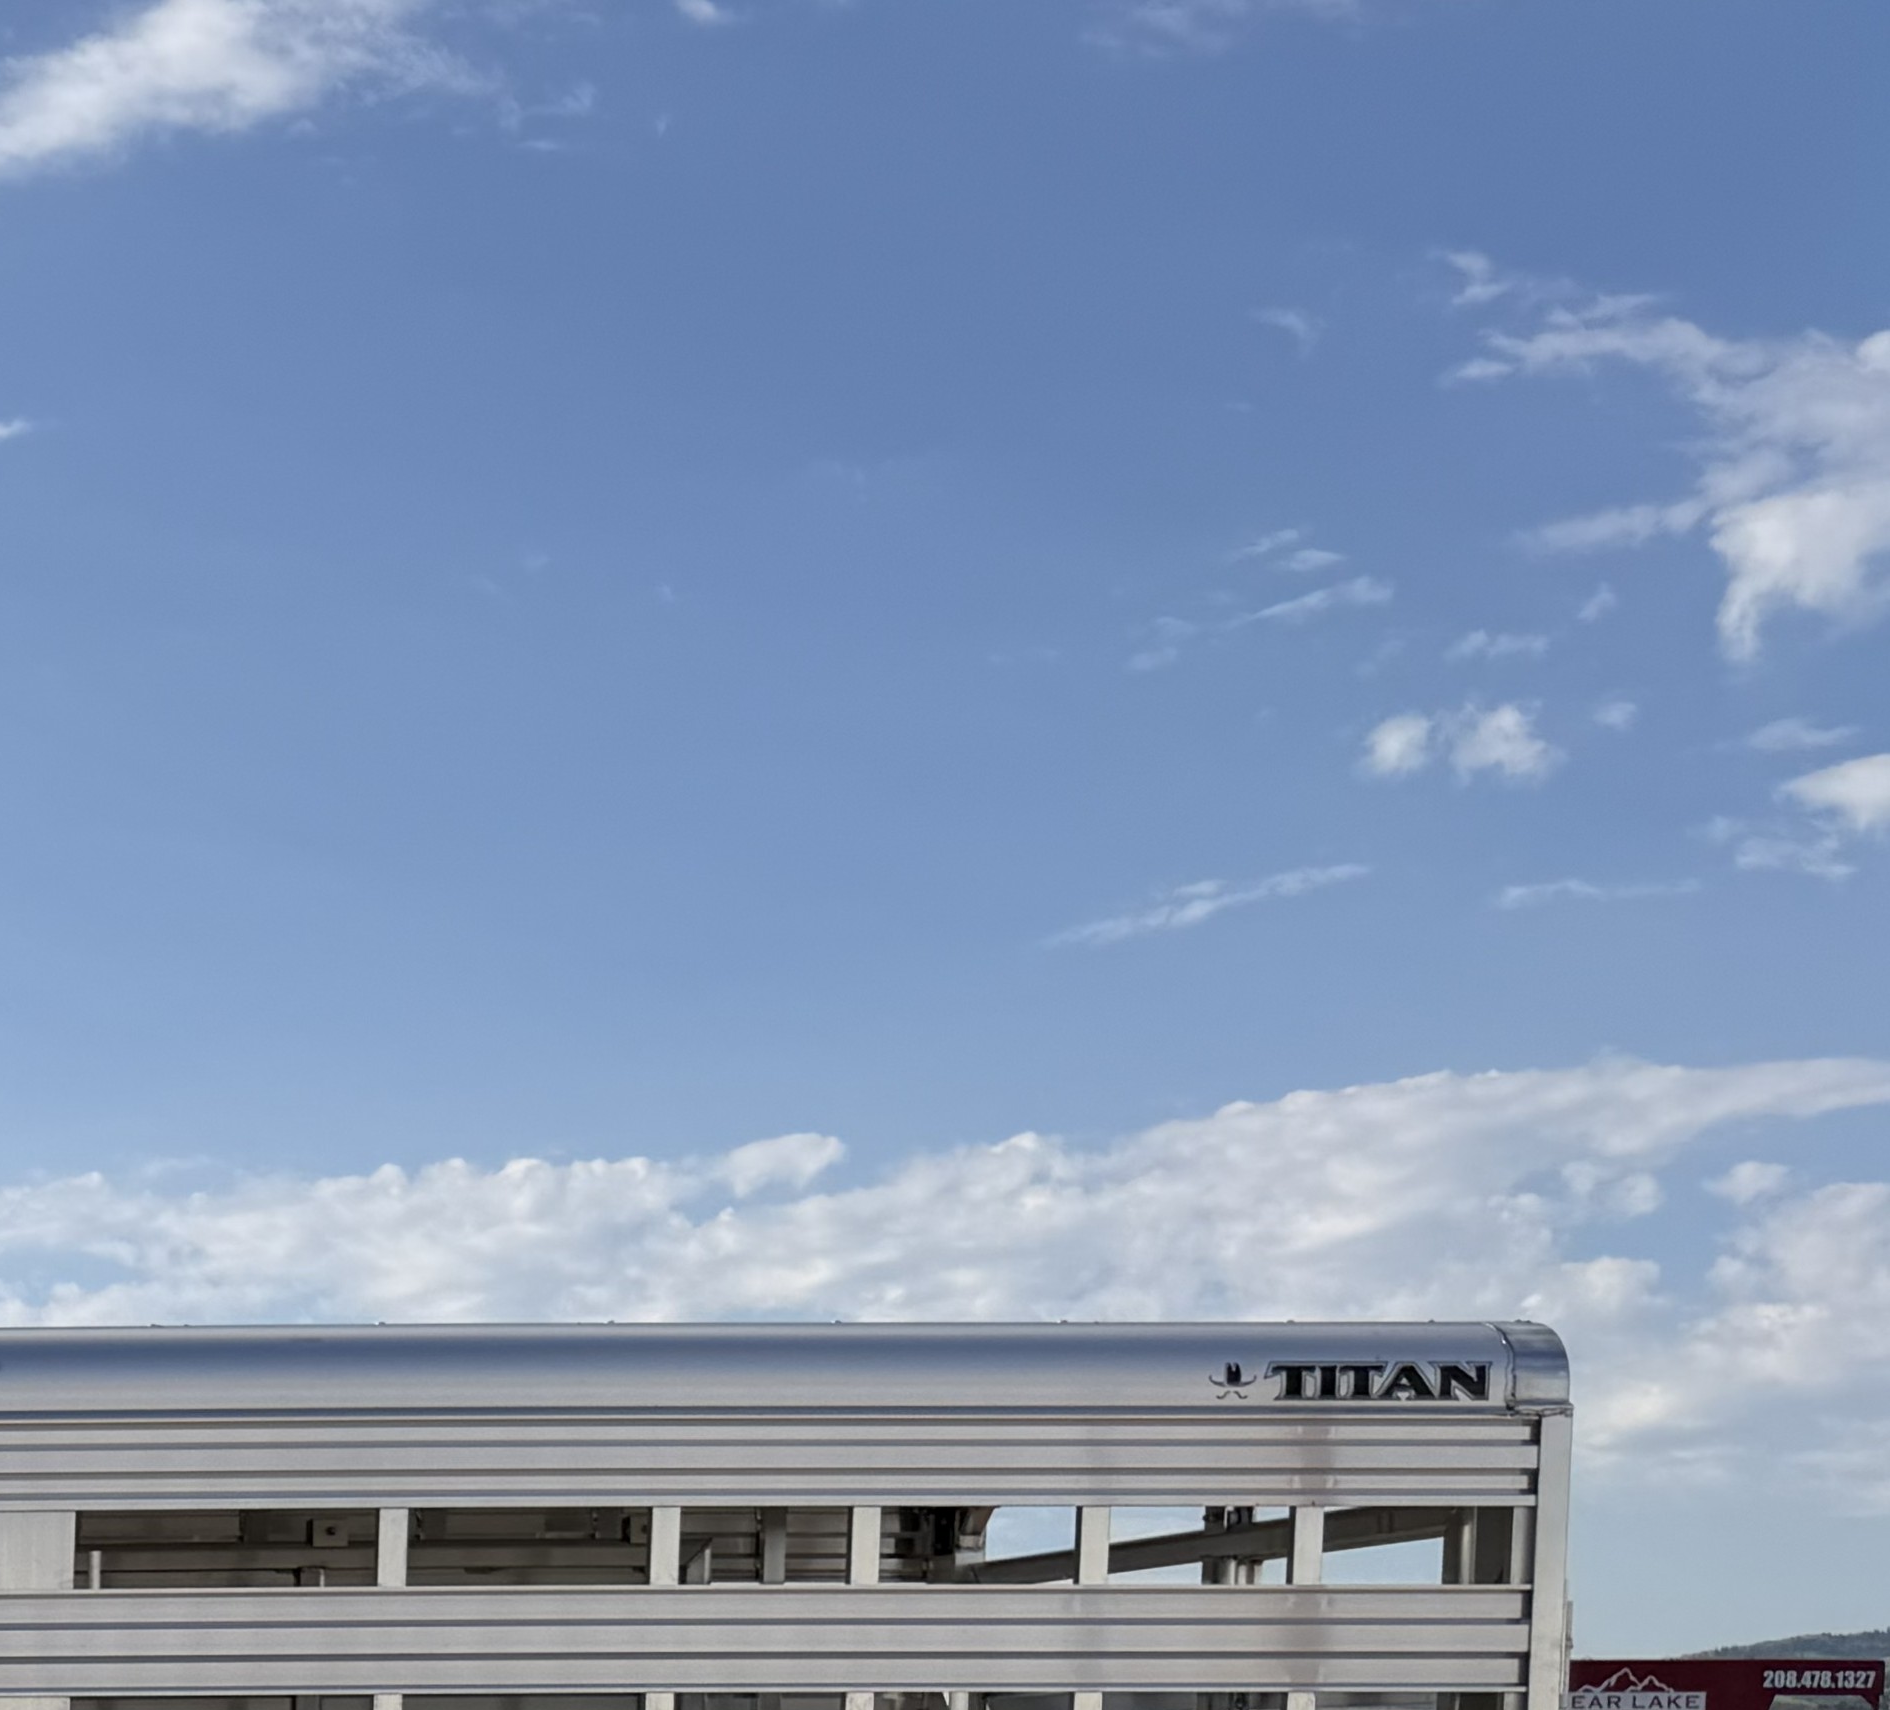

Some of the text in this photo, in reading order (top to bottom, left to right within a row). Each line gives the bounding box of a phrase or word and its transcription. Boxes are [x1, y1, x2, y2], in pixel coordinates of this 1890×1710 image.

[1264, 1361, 1492, 1400] TITAN
[1762, 1670, 1876, 1688] 208.478.1327
[1569, 1694, 1701, 1709] EAR LAKE
